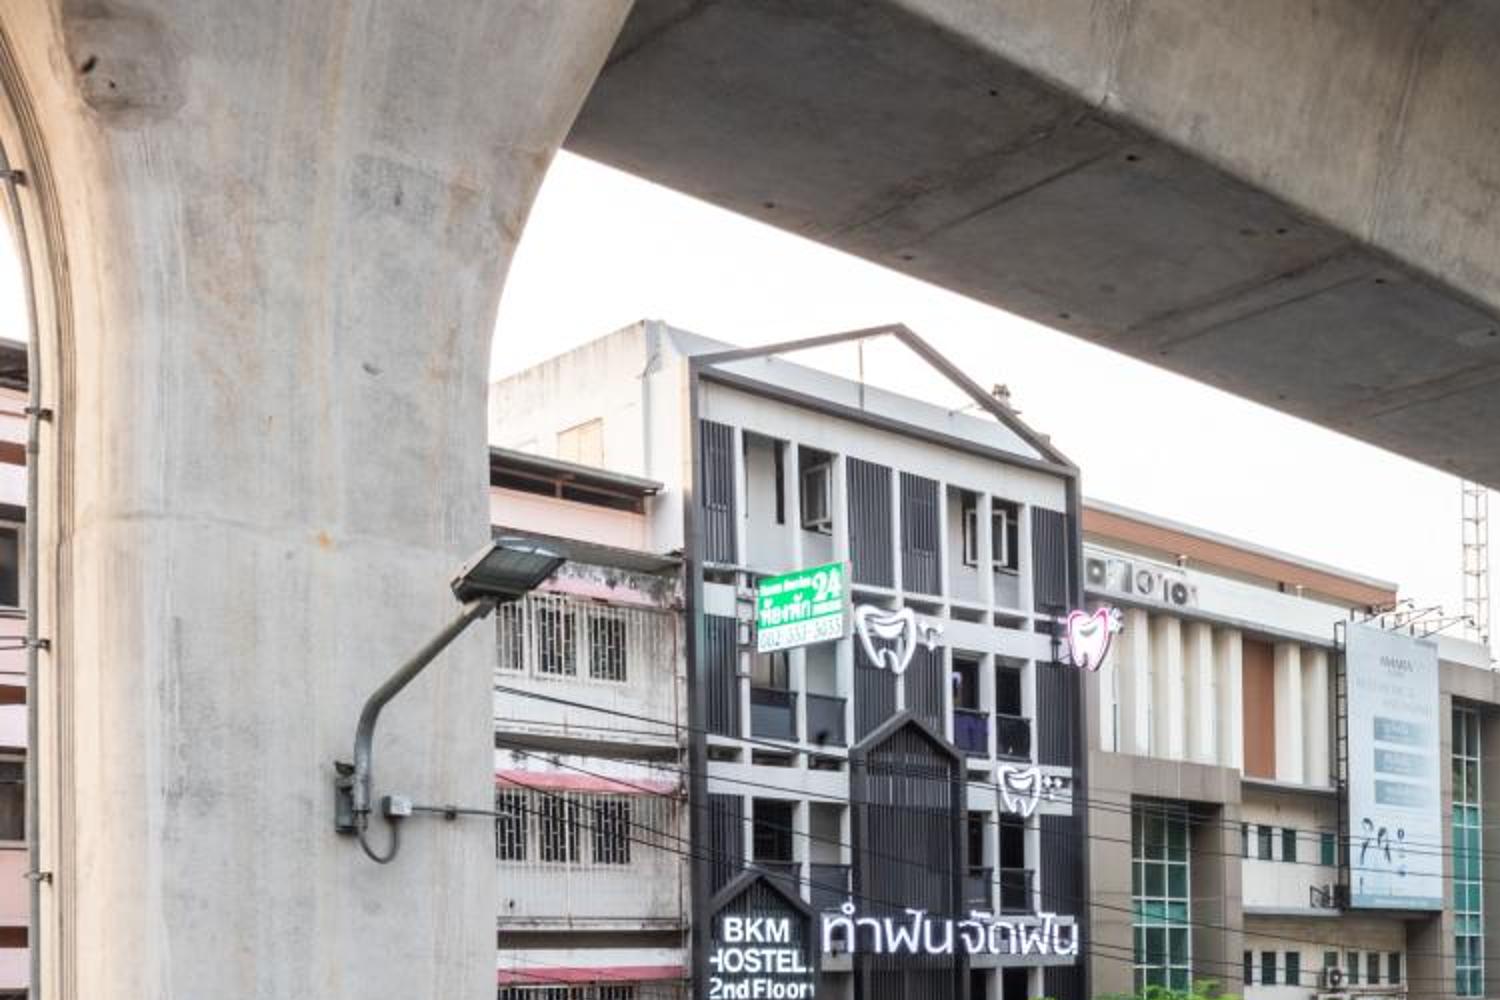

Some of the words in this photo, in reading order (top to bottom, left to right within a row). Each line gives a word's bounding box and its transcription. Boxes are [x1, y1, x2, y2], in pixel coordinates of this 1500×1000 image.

[724, 918, 790, 943] BKM
[709, 948, 807, 974] HOSTEL
[709, 977, 749, 1000] 2nd
[753, 977, 807, 1000] Floor
